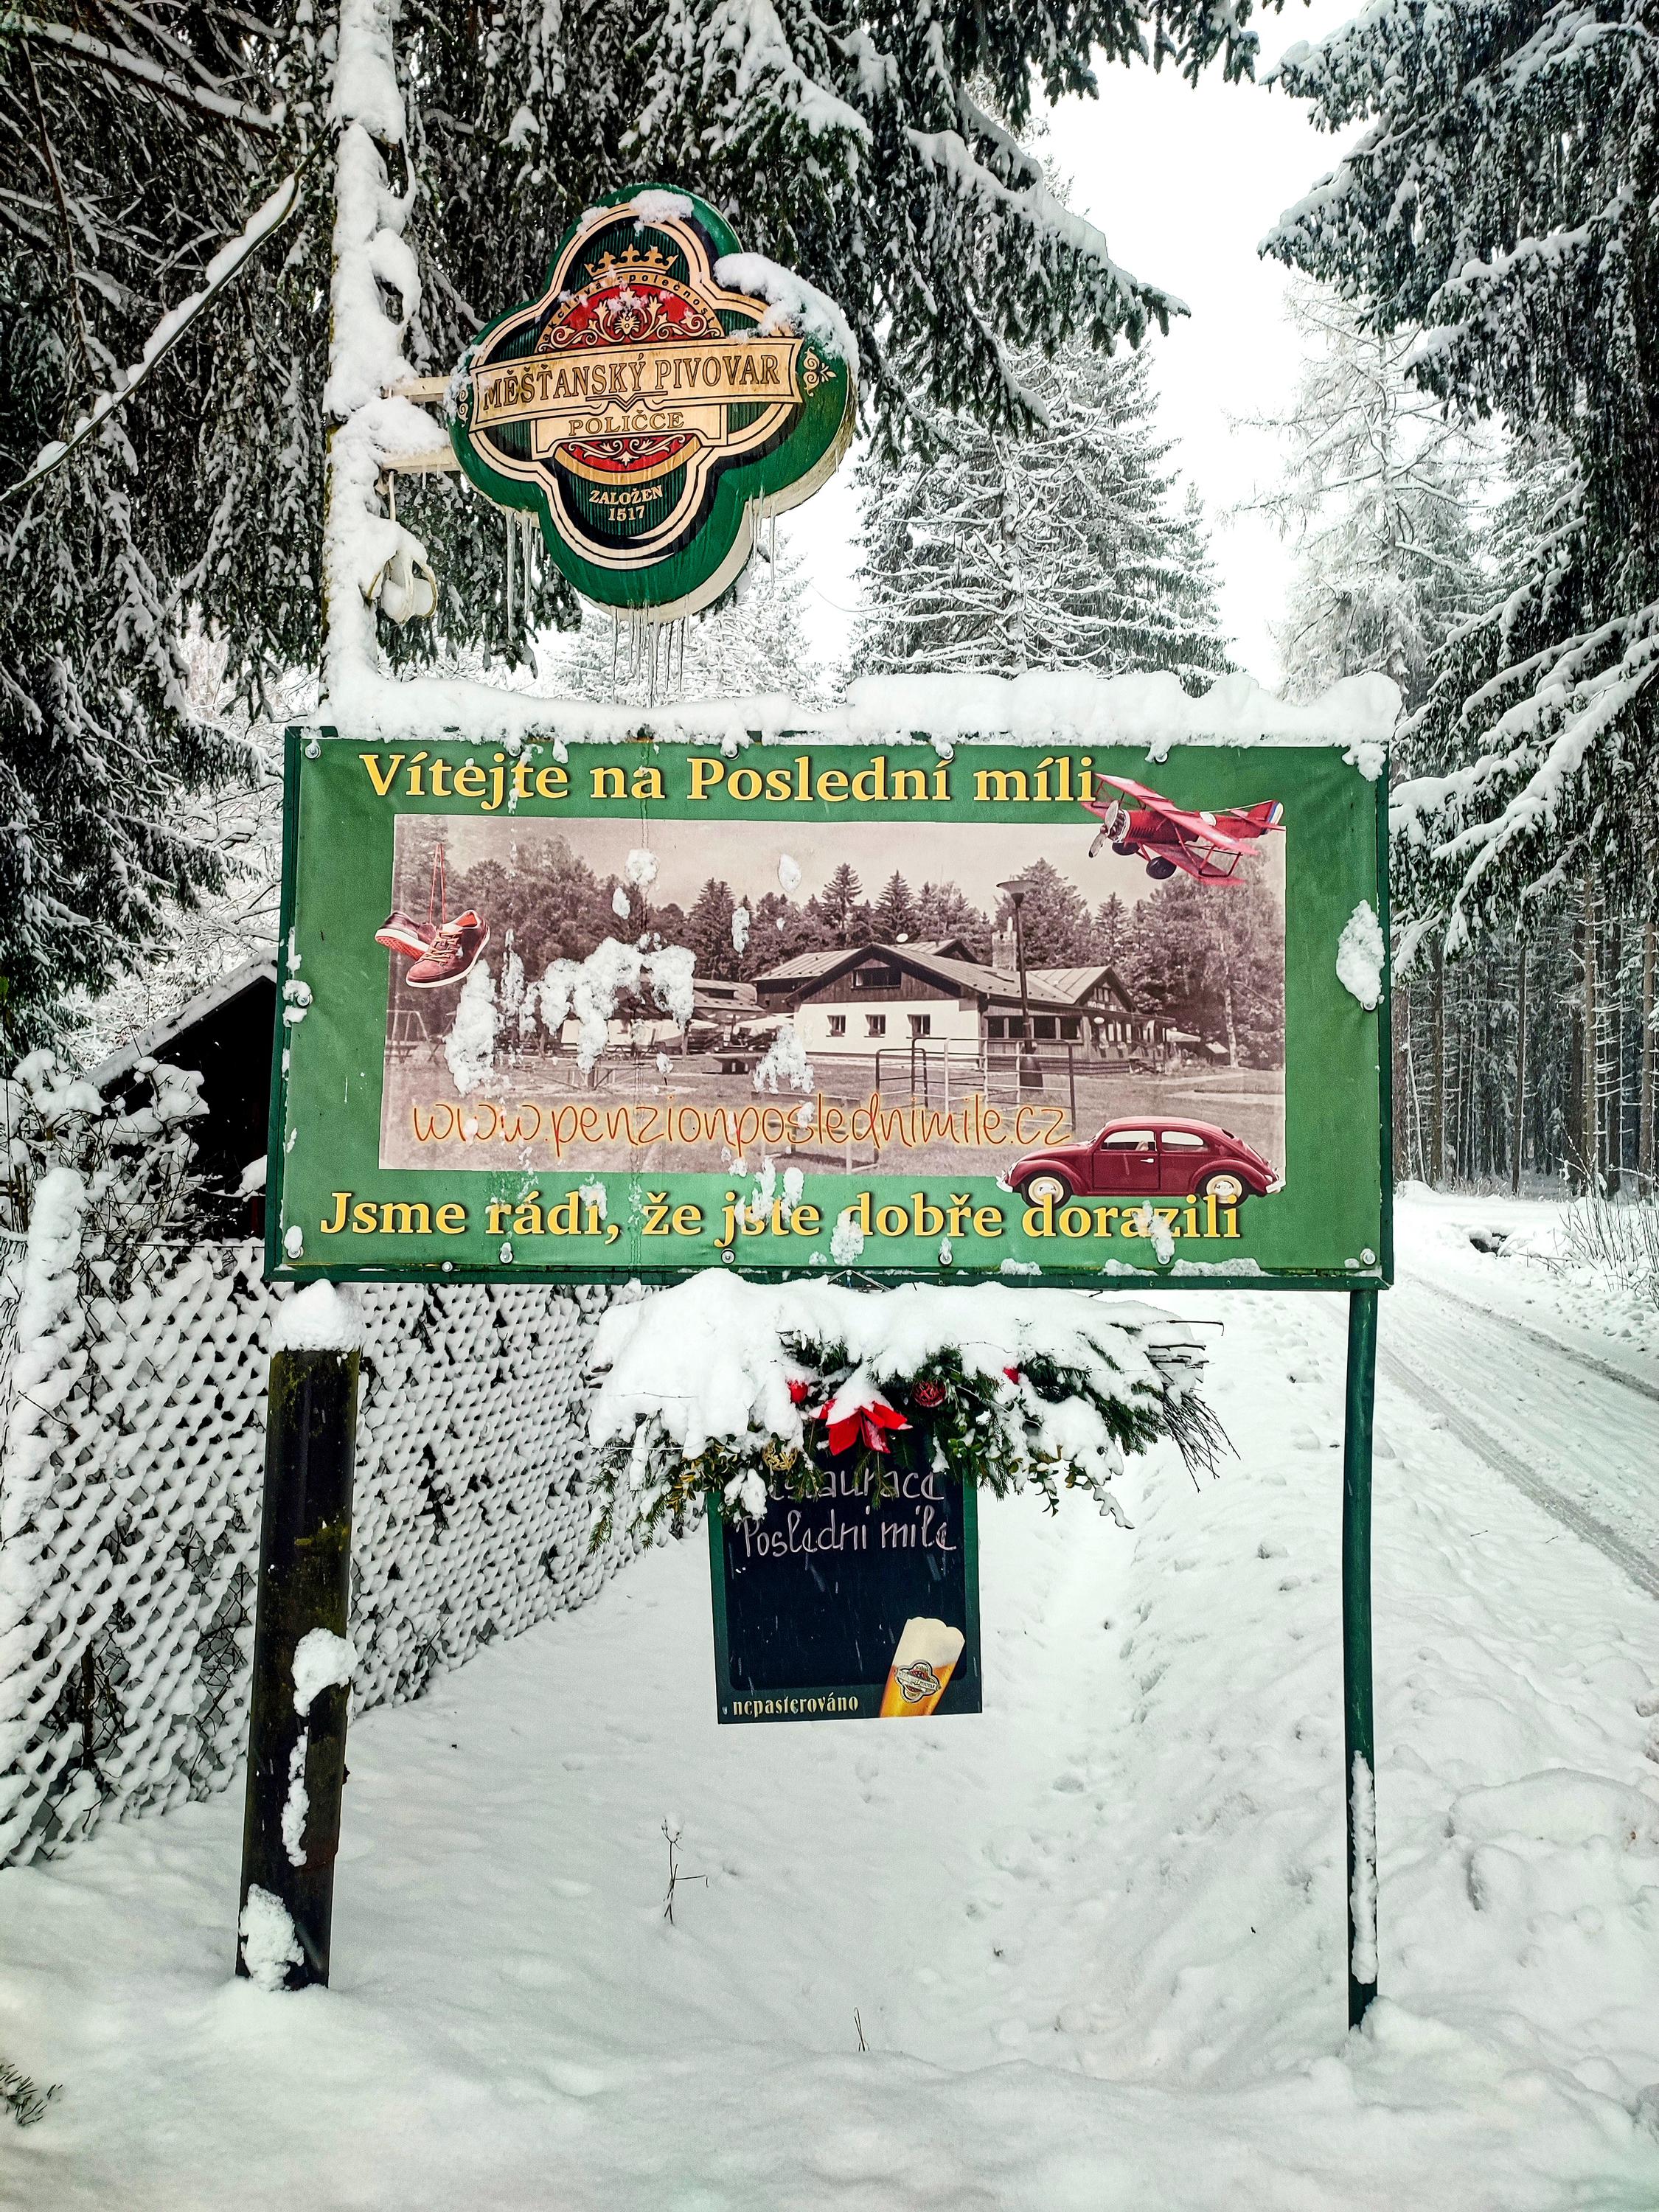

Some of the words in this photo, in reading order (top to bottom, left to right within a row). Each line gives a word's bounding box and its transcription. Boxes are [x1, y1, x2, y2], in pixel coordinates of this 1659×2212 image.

[482, 353, 647, 410] MĚŠŤANSKÝ
[655, 354, 781, 389] PIVOVAR
[568, 410, 685, 437] POLIČCE
[588, 484, 664, 504] ZALOŽEN
[608, 504, 646, 521] 1517
[358, 751, 569, 810] Vítejte
[590, 765, 665, 800] na
[686, 755, 952, 801] Poslední
[973, 755, 1096, 802] míli
[412, 1093, 1072, 1158] www.penzionposlednimile.cz
[319, 1192, 466, 1234] Jsme
[485, 1190, 619, 1245] rádi,
[641, 1192, 703, 1236] že
[713, 1192, 821, 1248] jste
[833, 1192, 1004, 1237] dobře
[1022, 1194, 1241, 1238] dorazili
[732, 1691, 860, 1719] nepasterováno
